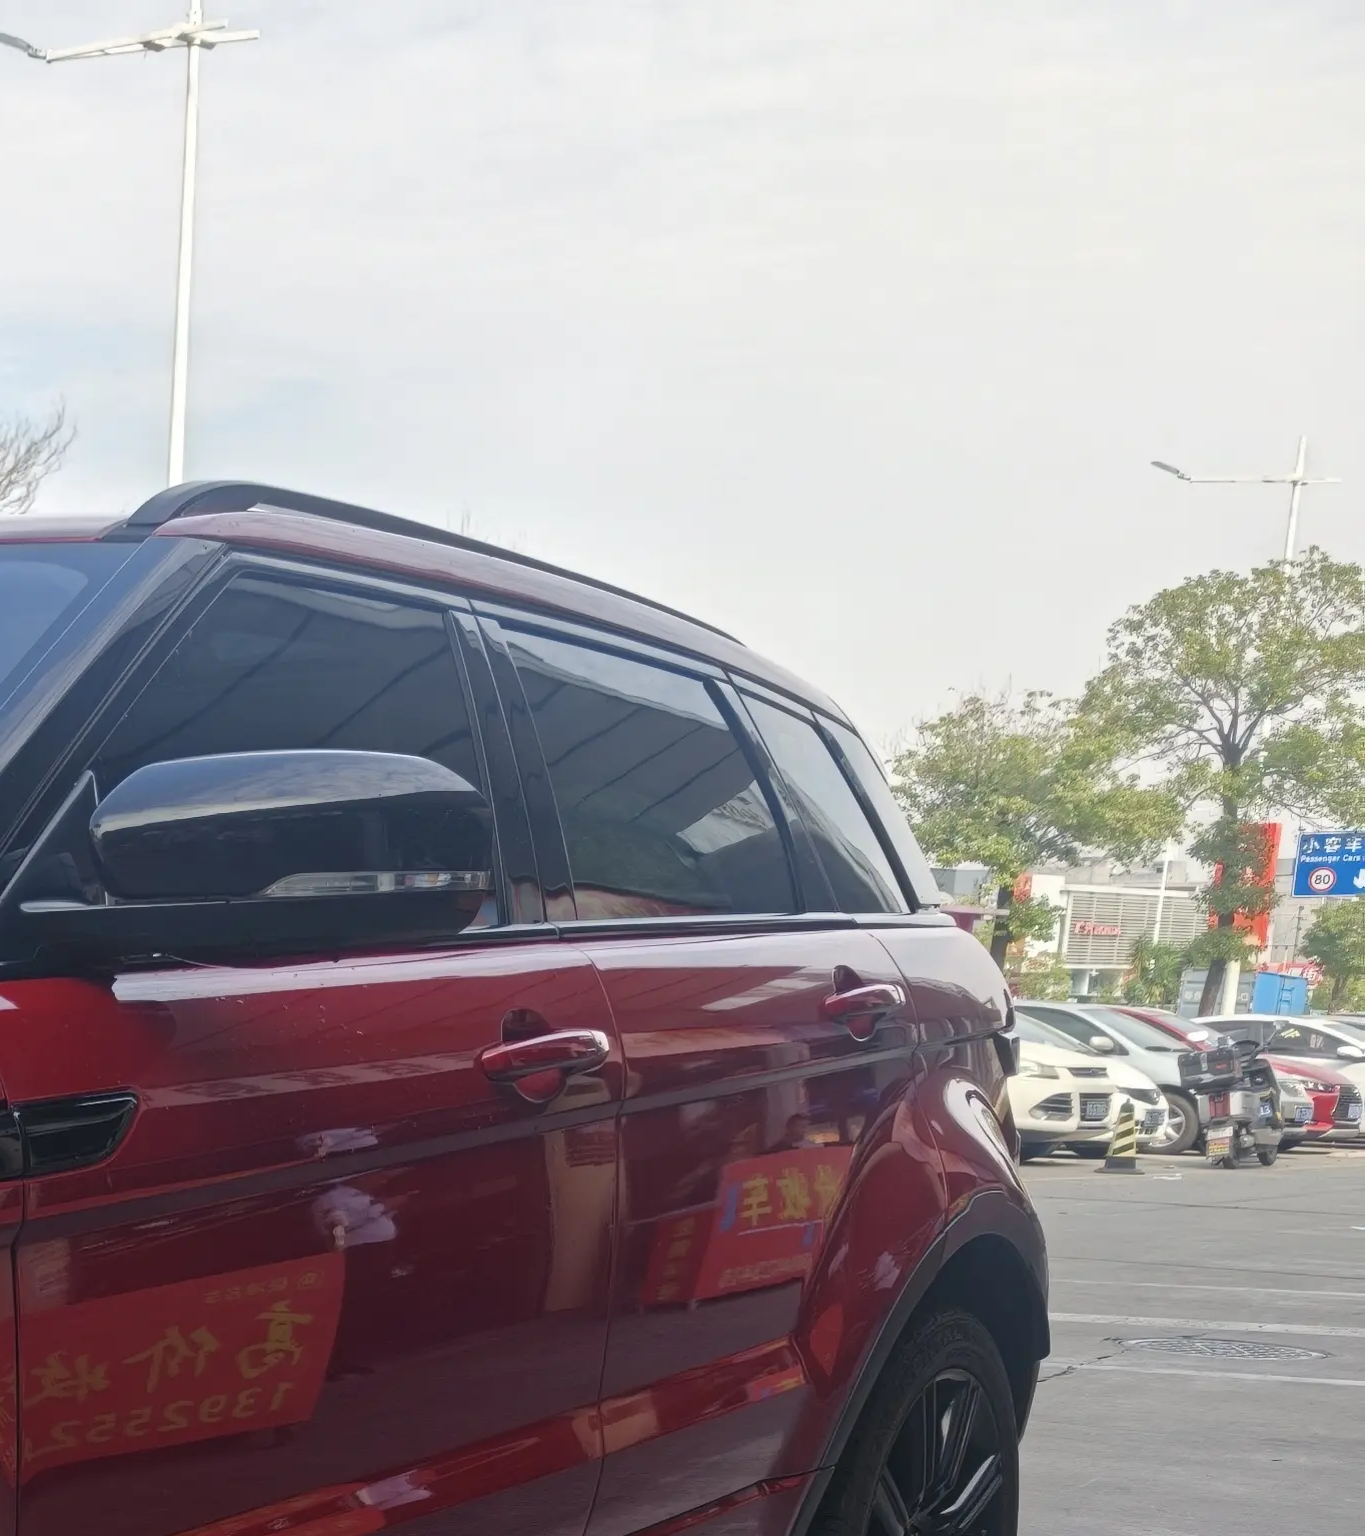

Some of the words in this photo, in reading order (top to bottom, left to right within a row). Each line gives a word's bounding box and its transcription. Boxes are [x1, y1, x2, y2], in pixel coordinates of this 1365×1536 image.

[1300, 855, 1341, 864] Passenger
[1343, 854, 1362, 863] Cars
[1314, 874, 1331, 885] 80
